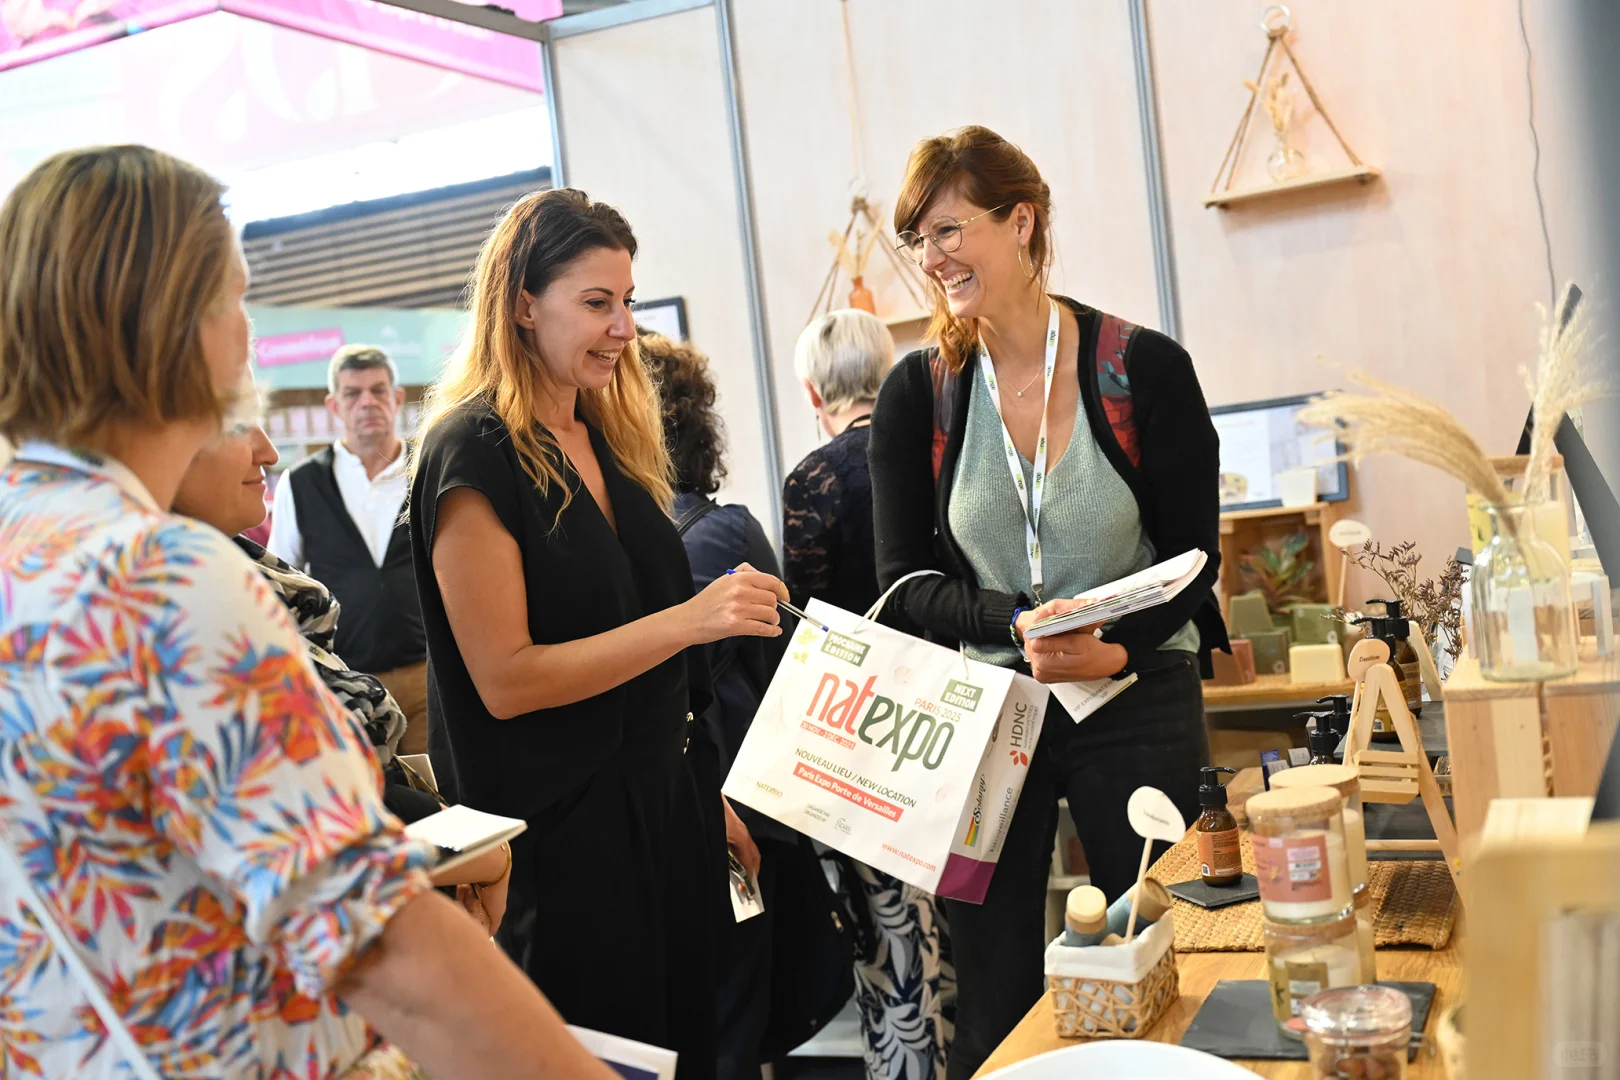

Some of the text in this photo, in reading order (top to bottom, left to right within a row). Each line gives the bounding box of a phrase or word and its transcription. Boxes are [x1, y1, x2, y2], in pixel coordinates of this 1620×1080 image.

[824, 641, 861, 664] ÉDITION
[828, 633, 866, 654] PROCHAINE
[943, 692, 977, 710] EDITION
[954, 683, 977, 698] NEXT
[806, 672, 955, 772] natexpo
[914, 697, 962, 722] PARIS 2025
[1010, 702, 1027, 747] HDNC
[840, 738, 854, 750] 2025
[795, 748, 833, 770] NOUVEAU
[832, 764, 852, 778] LIEU
[856, 776, 878, 790] NEW
[877, 785, 917, 808] LOCATION
[798, 767, 897, 818] Paris Expo Porte de Versailles
[881, 843, 936, 871] www.natexpo.com
